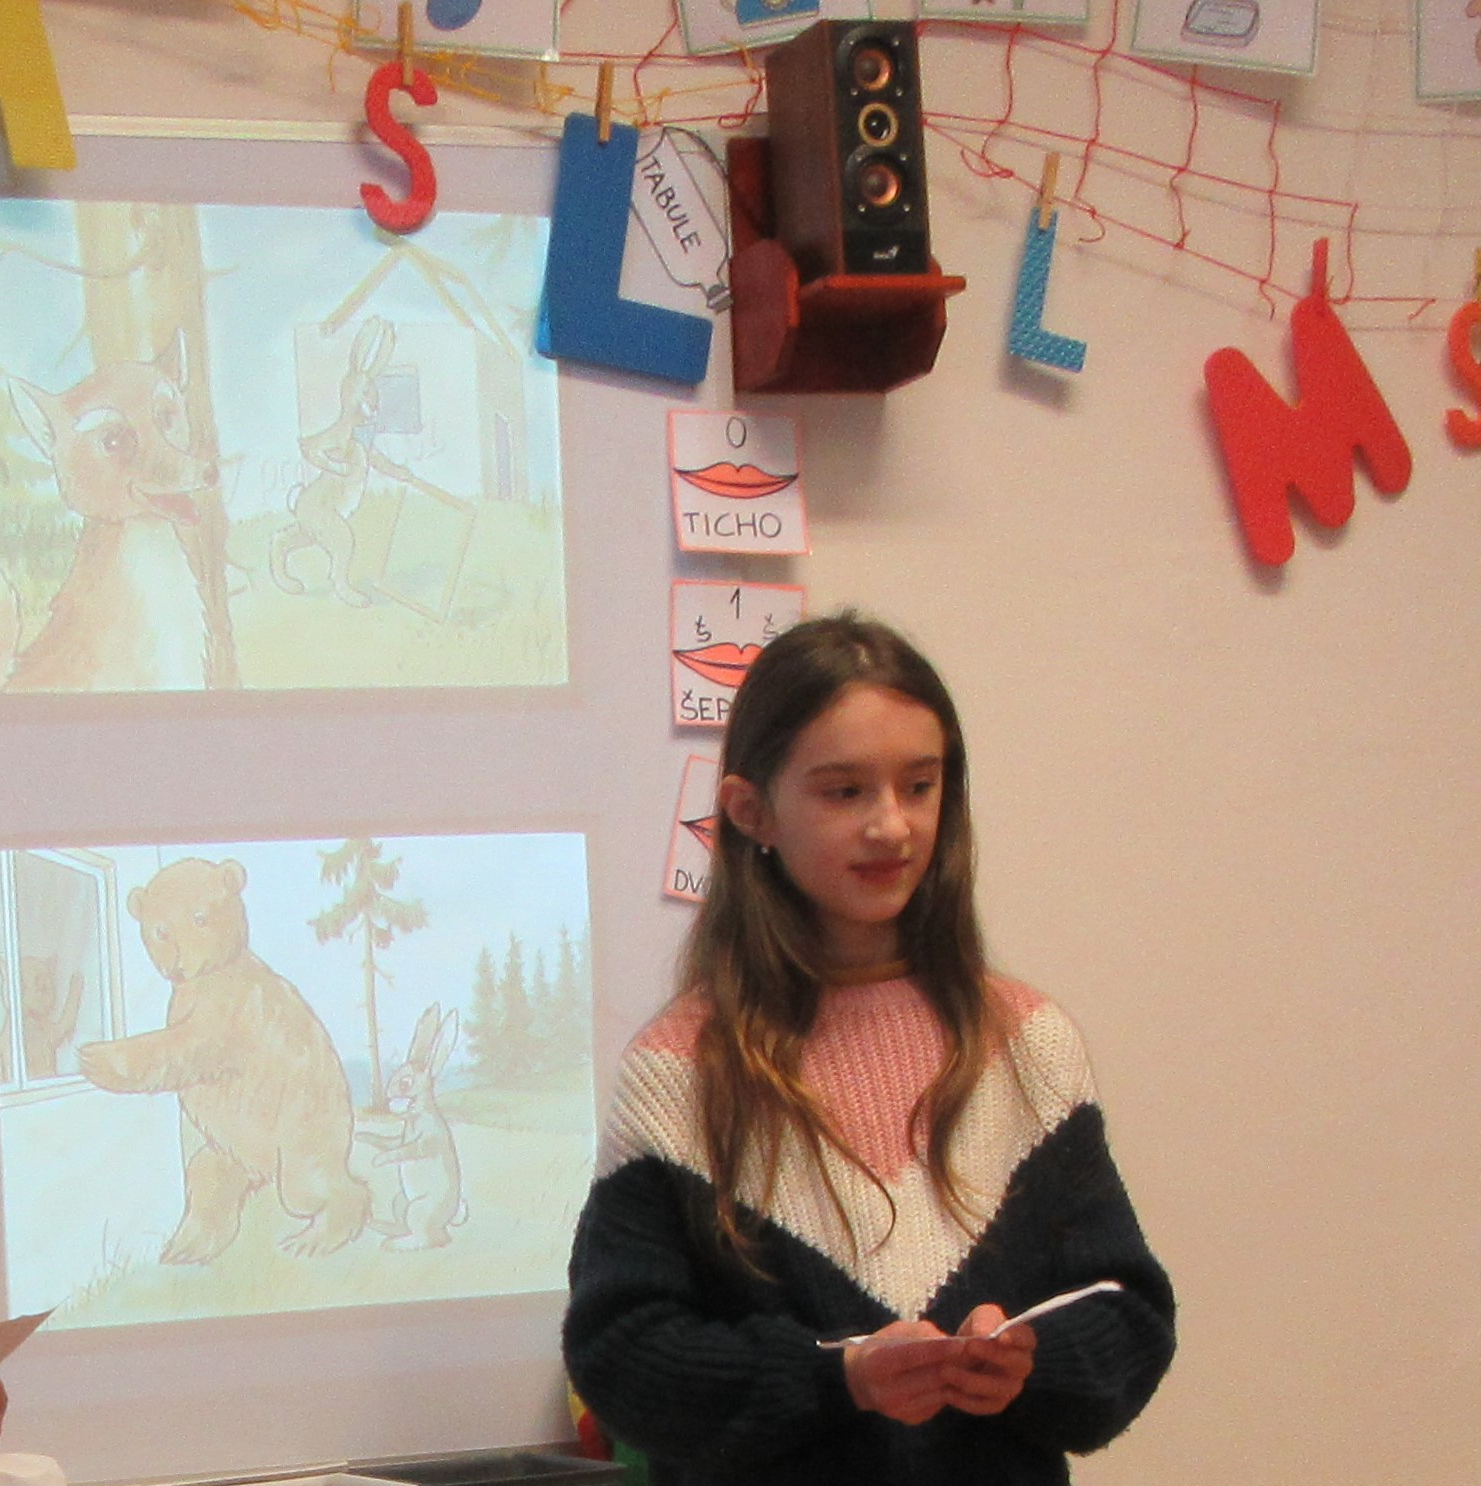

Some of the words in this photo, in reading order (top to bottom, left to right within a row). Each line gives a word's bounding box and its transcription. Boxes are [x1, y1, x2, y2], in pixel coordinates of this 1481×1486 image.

[360, 62, 438, 234] S
[533, 112, 713, 385] L
[640, 156, 703, 255] TABULE
[1009, 207, 1087, 373] L
[1204, 294, 1413, 567] M
[683, 511, 783, 540] TICHO
[729, 587, 741, 620] 1
[680, 689, 730, 722] ŠEP
[674, 869, 704, 893] DV
